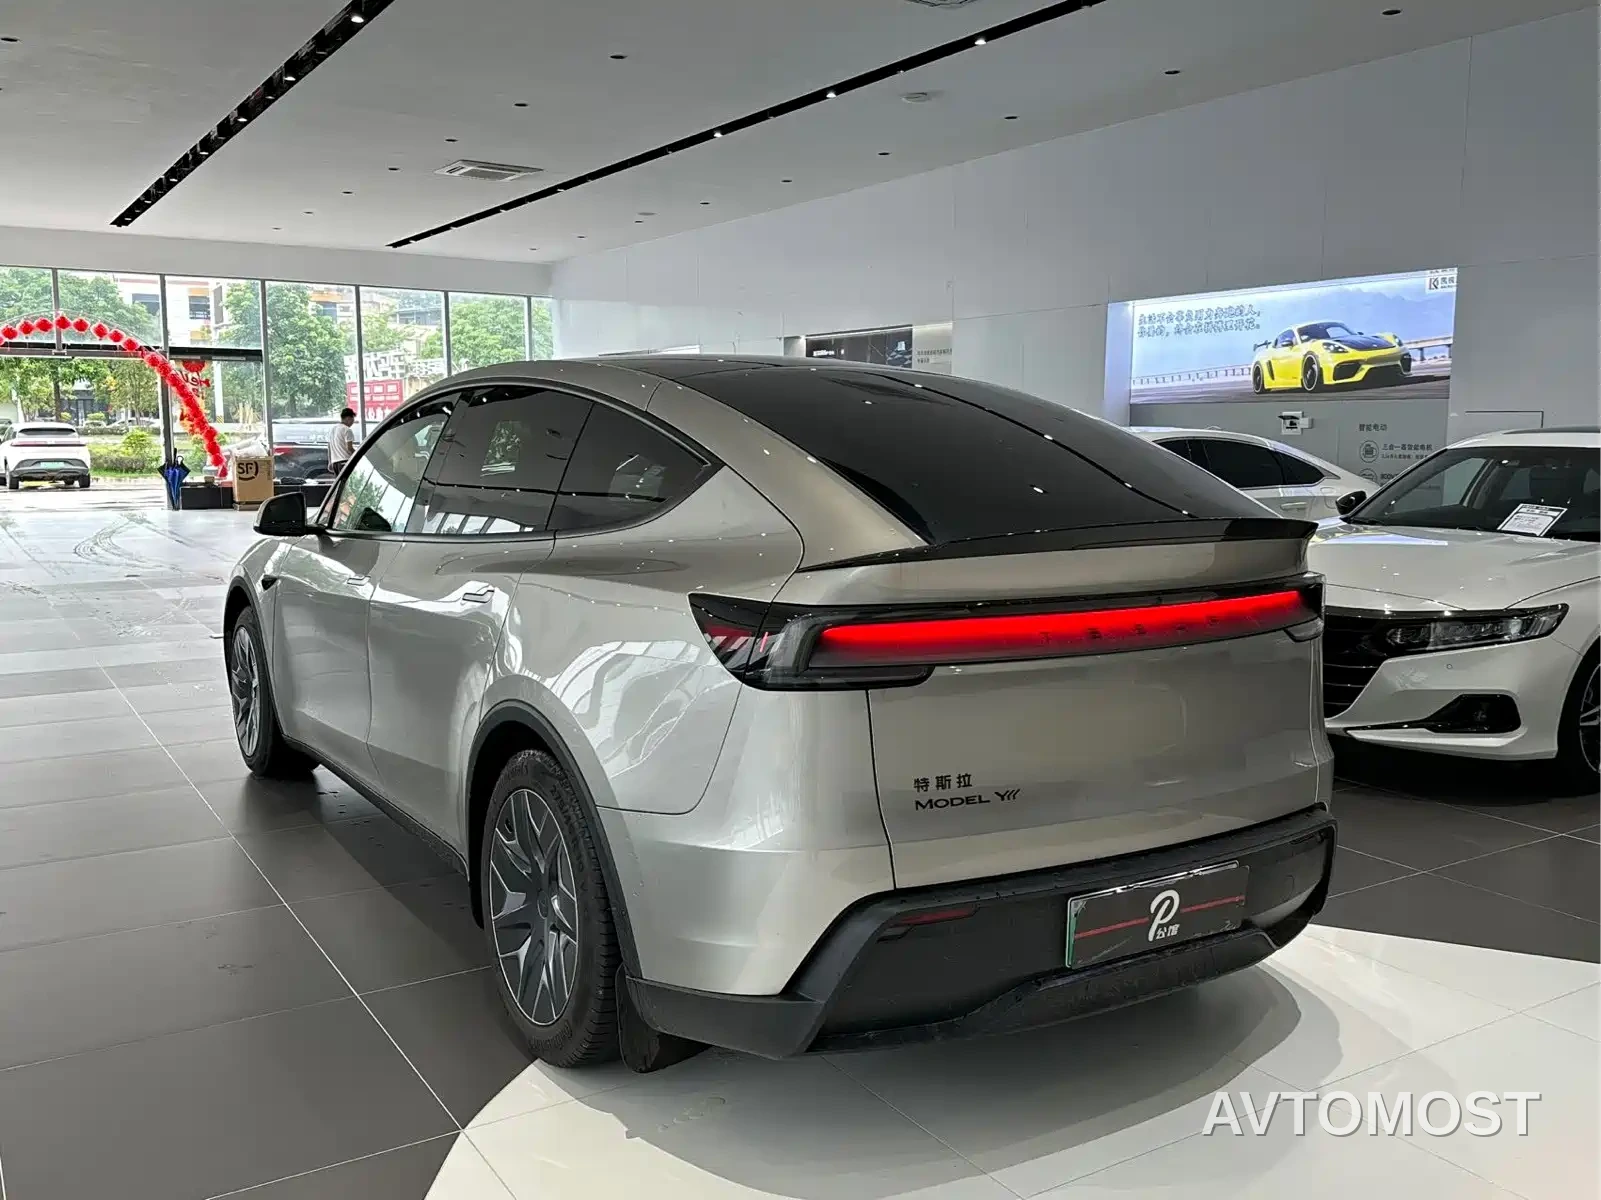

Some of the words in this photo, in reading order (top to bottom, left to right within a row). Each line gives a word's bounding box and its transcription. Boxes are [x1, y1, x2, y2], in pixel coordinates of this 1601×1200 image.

[913, 773, 973, 792] 特斯拉
[915, 795, 991, 811] MODEL
